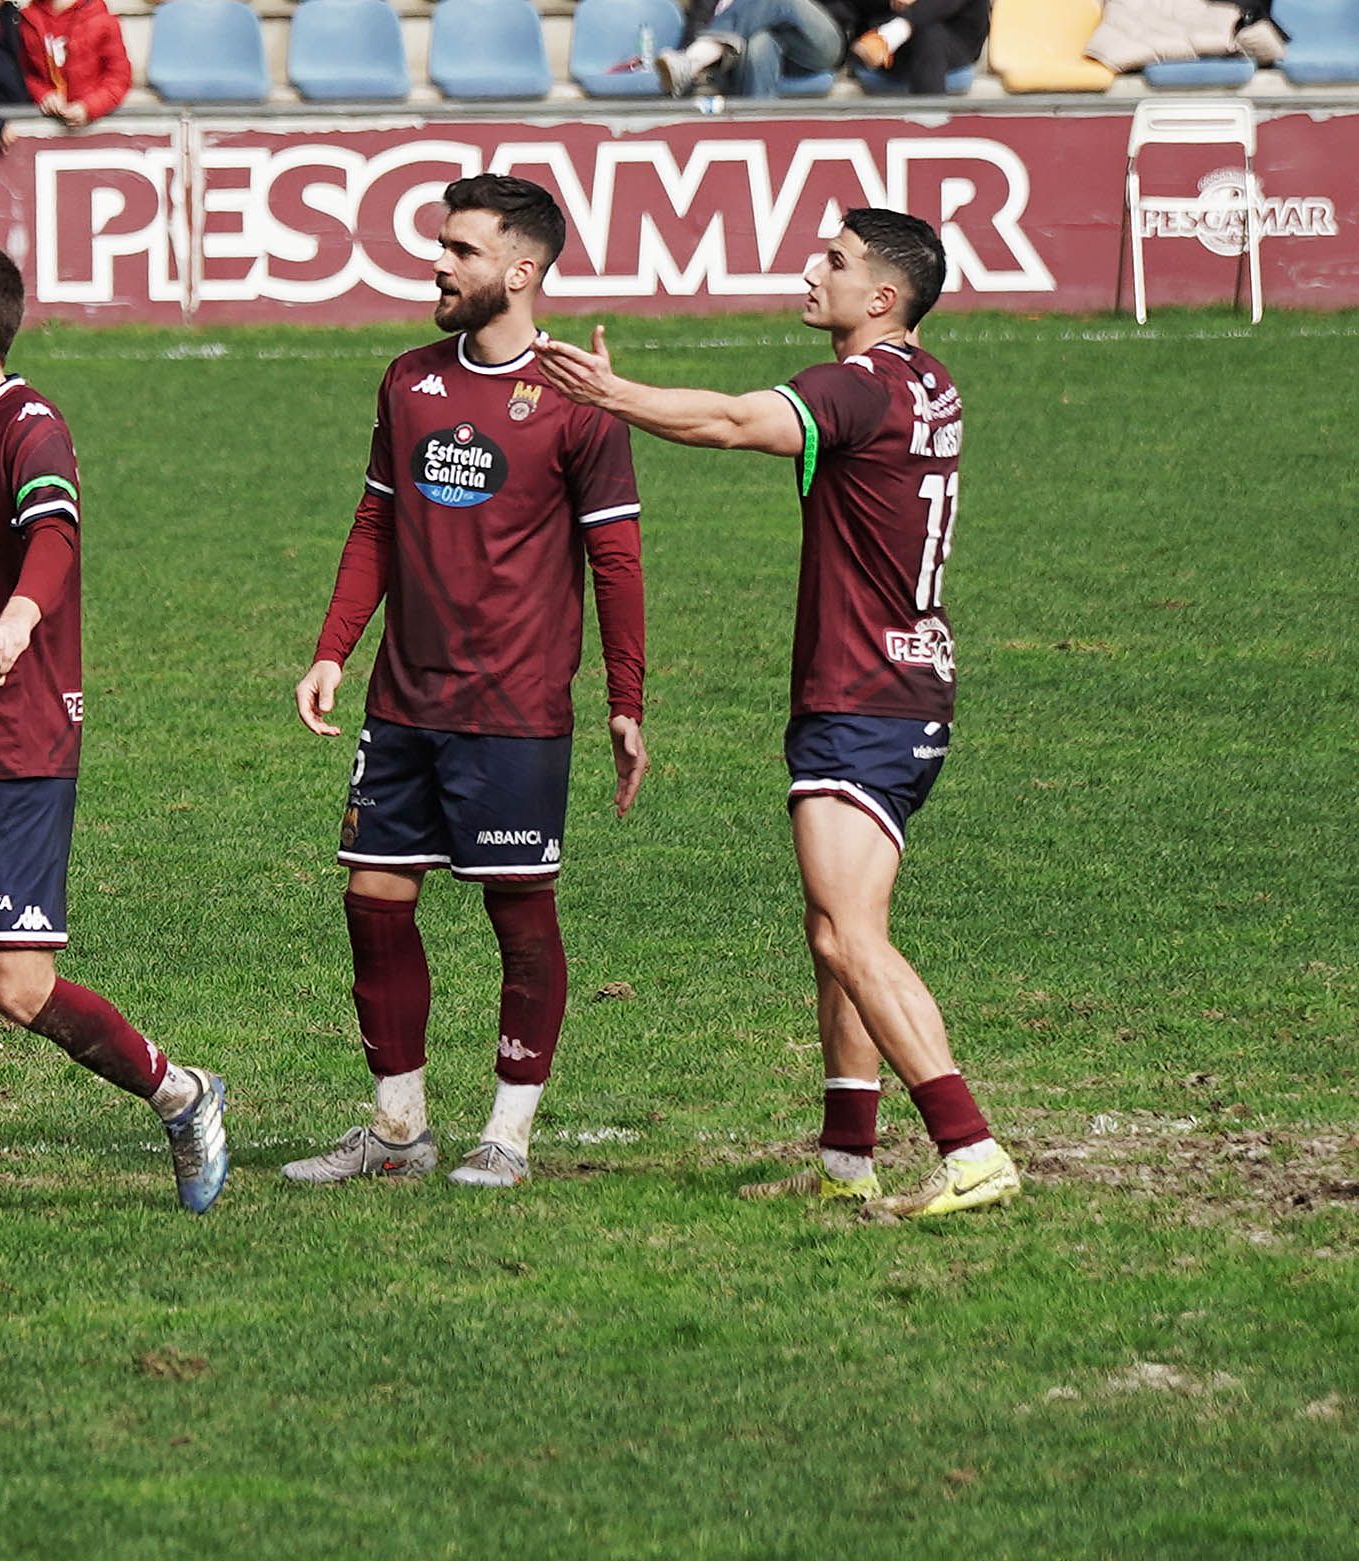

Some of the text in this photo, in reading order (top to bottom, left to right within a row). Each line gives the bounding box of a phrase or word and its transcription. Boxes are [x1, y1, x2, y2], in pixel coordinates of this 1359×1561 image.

[35, 138, 1055, 304] PESCAMAR
[424, 439, 492, 469] Estrella
[424, 460, 486, 489] Galicia
